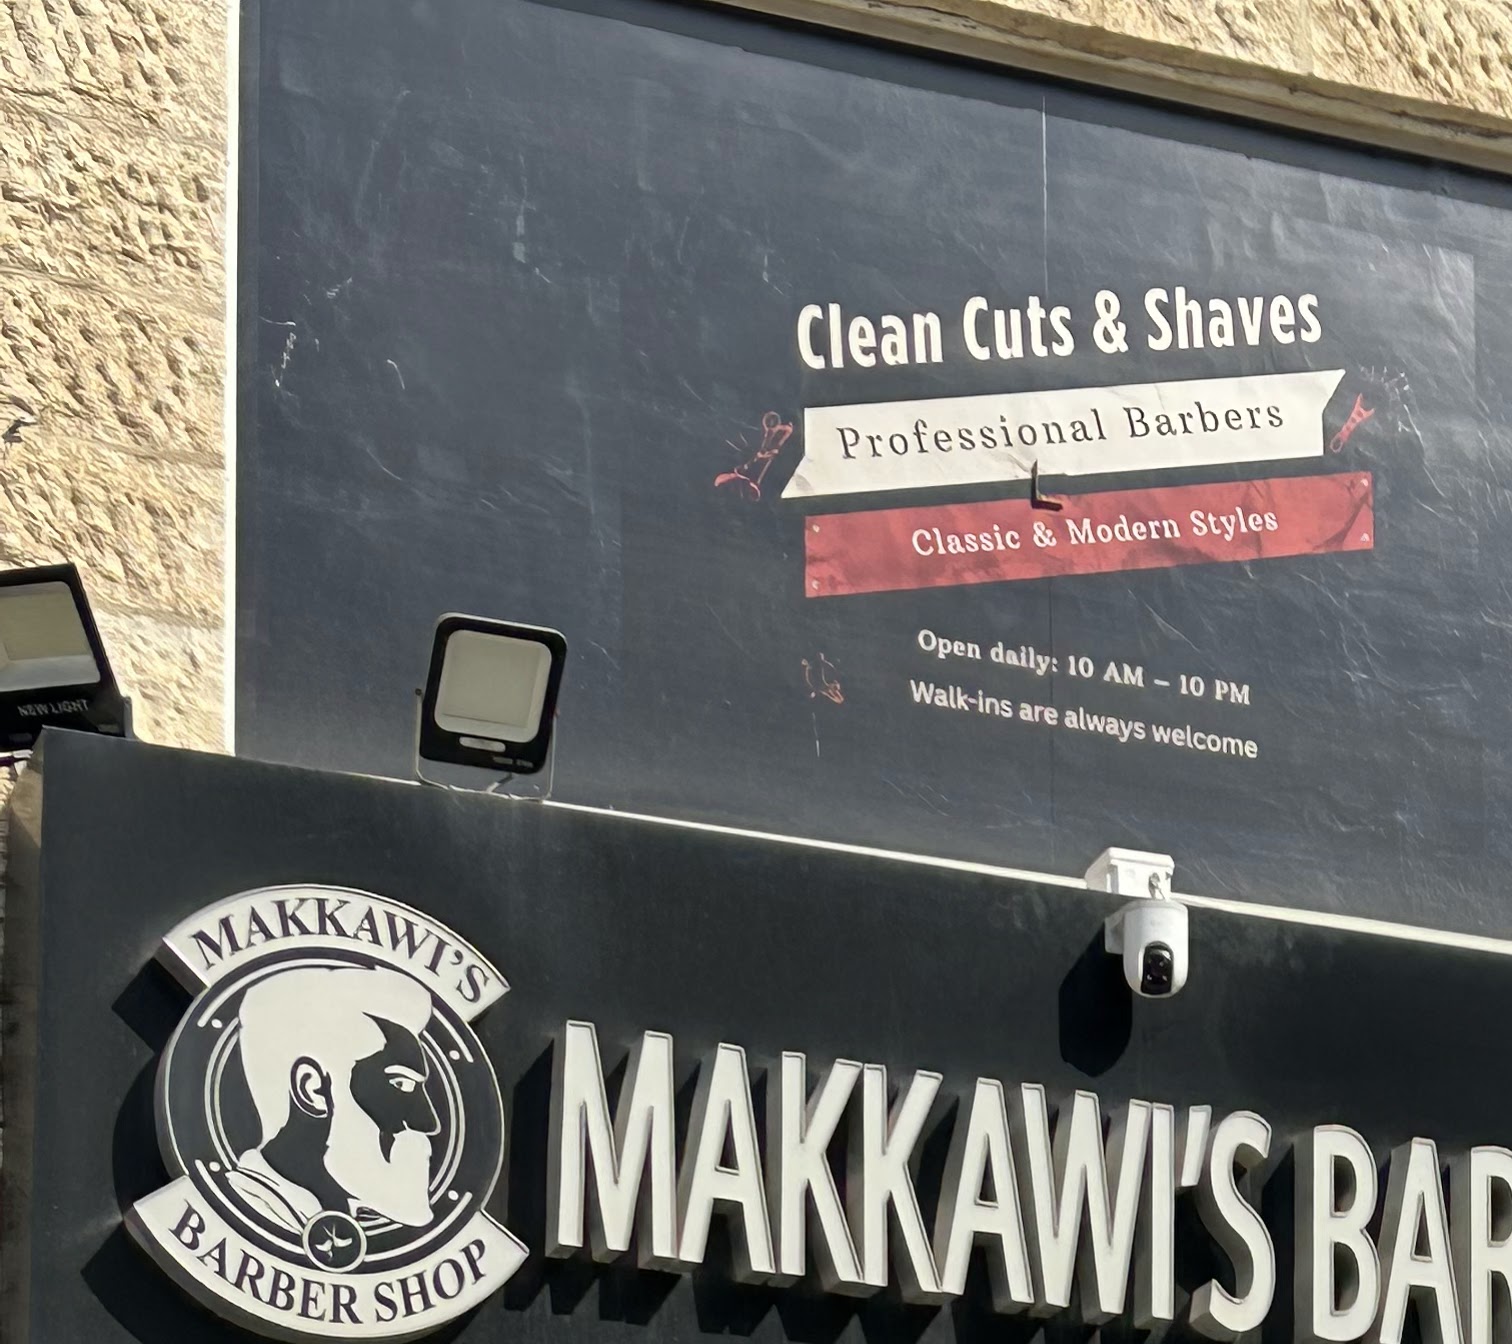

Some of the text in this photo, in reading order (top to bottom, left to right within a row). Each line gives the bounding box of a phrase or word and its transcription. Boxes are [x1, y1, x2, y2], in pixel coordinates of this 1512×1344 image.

[797, 285, 1322, 369] Clean Cuts & Shaves
[837, 401, 1284, 459] Professional Barbers
[911, 505, 1278, 556] Classic & Modern Styles
[917, 629, 982, 661] Open
[990, 642, 1058, 676] daily:
[1068, 655, 1094, 679] 10
[1103, 661, 1144, 687] AM
[1180, 674, 1205, 697] 10
[1214, 679, 1250, 706] PM
[909, 679, 1258, 759] Walk-ins are always welcome
[191, 896, 490, 1004] MAKKAWI'S
[557, 1020, 1276, 1332] MAKKAWI'S
[168, 1199, 487, 1326] BARBER SHOP
